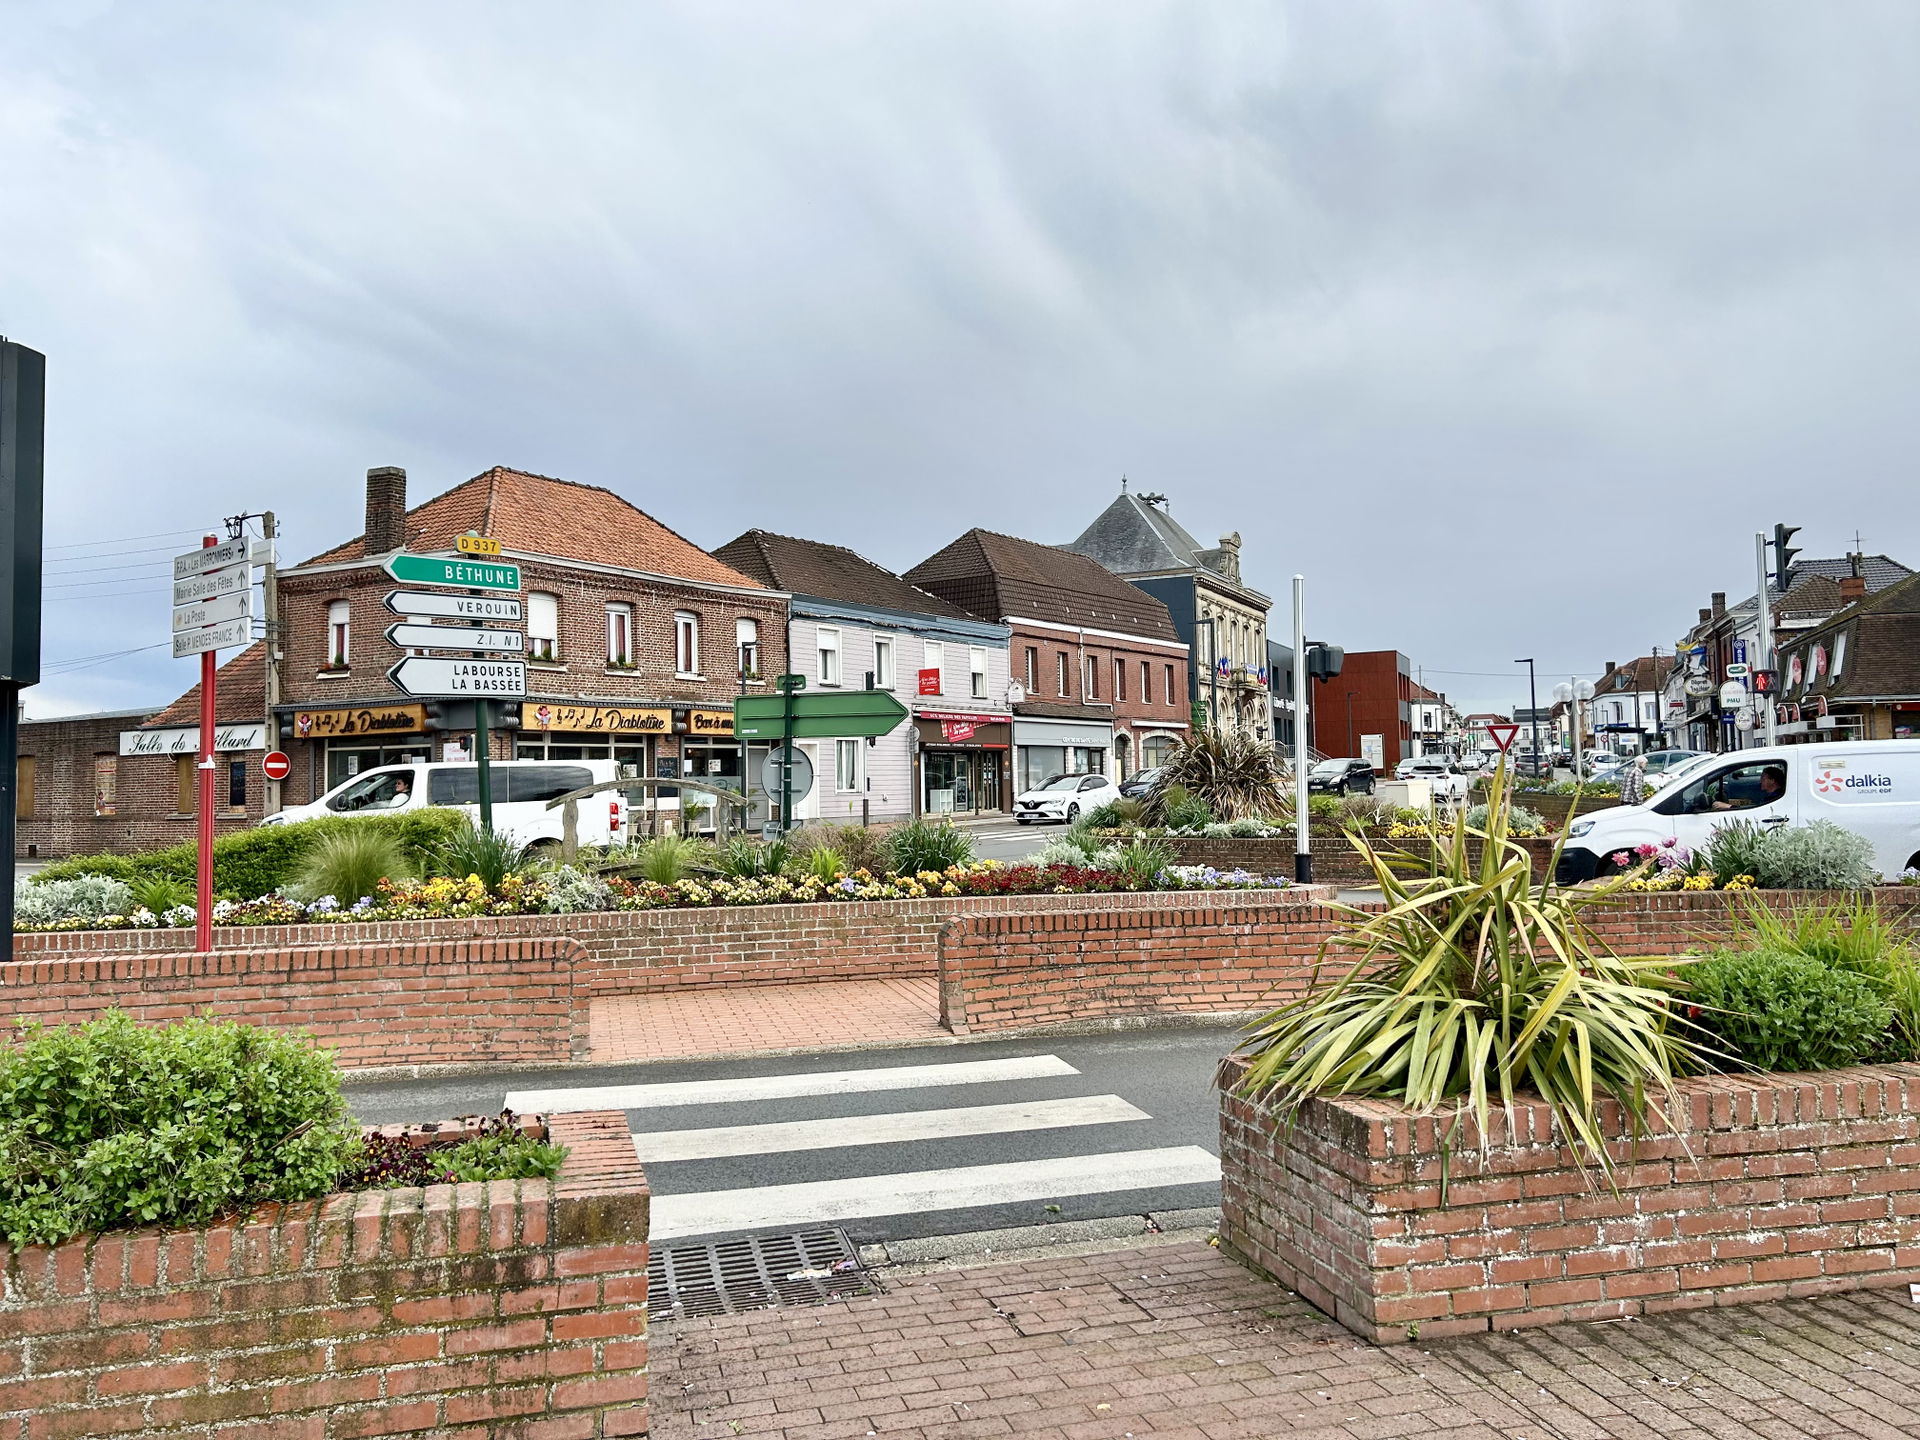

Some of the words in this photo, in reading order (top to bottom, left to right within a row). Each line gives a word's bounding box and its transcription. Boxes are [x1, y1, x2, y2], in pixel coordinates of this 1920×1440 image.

[461, 538, 469, 549] D
[473, 539, 497, 552] 937
[445, 563, 514, 584] BÉTHUNE
[176, 586, 192, 600] Mairie
[192, 581, 206, 597] Salle
[207, 579, 217, 593] des
[217, 576, 233, 591] Fêtes
[184, 612, 190, 625] La
[191, 609, 206, 623] Poste
[176, 639, 187, 652] Salle
[212, 628, 233, 644] FRANCE
[477, 634, 496, 646] Z.I.
[453, 664, 521, 677] LABOURSE
[452, 679, 467, 690] LA
[474, 677, 522, 691] BASSÉE
[340, 711, 356, 733] La
[357, 710, 415, 732] Diablotine
[586, 707, 603, 729] La
[605, 709, 666, 730] Diablotine
[694, 714, 713, 729] Bar
[129, 733, 163, 753] Salle
[171, 733, 186, 751] de
[1845, 774, 1892, 788] dalkia
